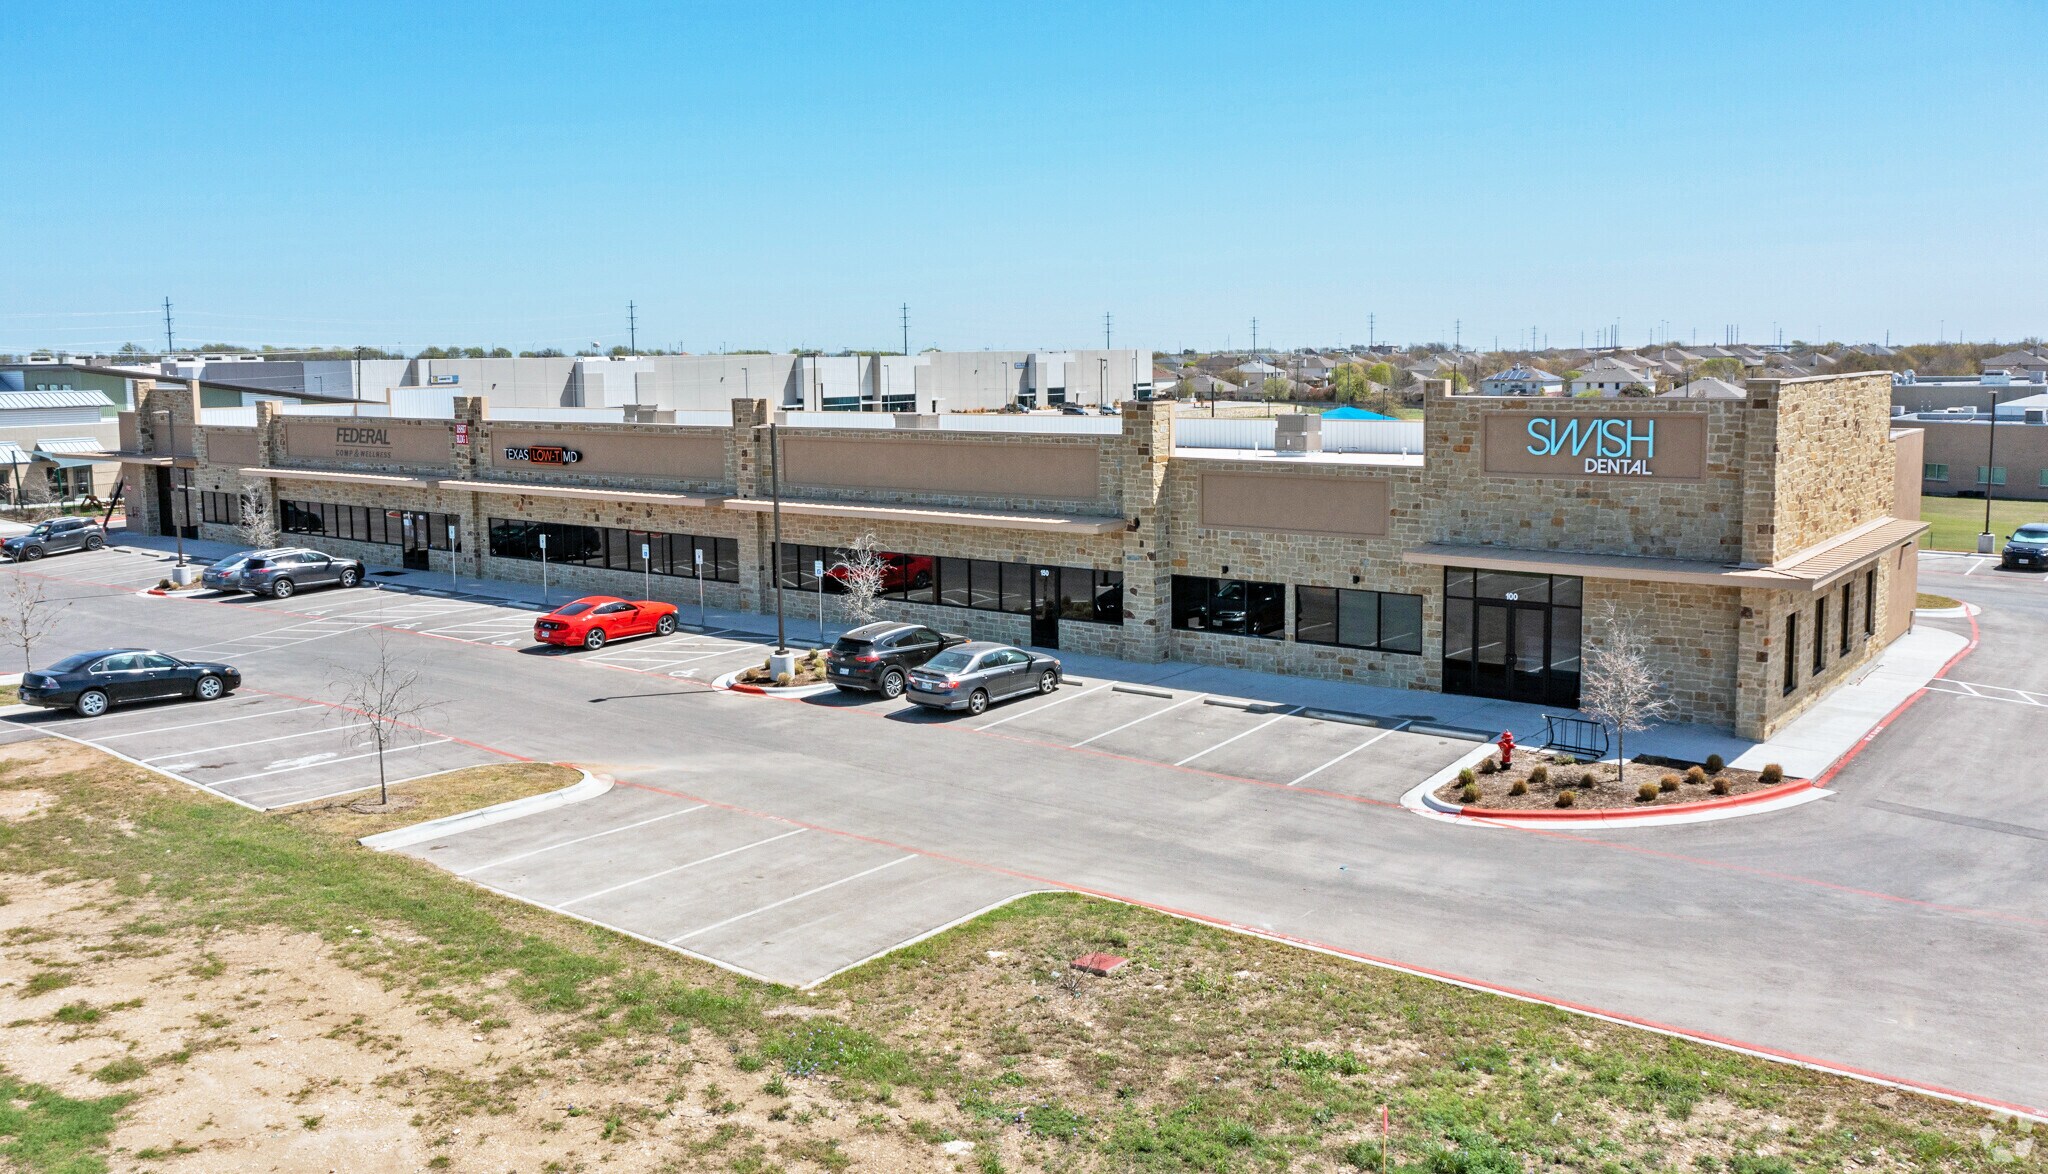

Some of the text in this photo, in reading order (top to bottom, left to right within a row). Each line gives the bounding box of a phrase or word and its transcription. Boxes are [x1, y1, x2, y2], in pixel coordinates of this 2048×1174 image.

[337, 427, 391, 445] FEDERAL
[1527, 418, 1654, 458] SWISH
[336, 449, 392, 459] COMP & WELLNESS
[503, 448, 579, 463] TEXAS LOW-T MD
[1585, 458, 1652, 475] DENTAL
[1505, 592, 1518, 601] 100
